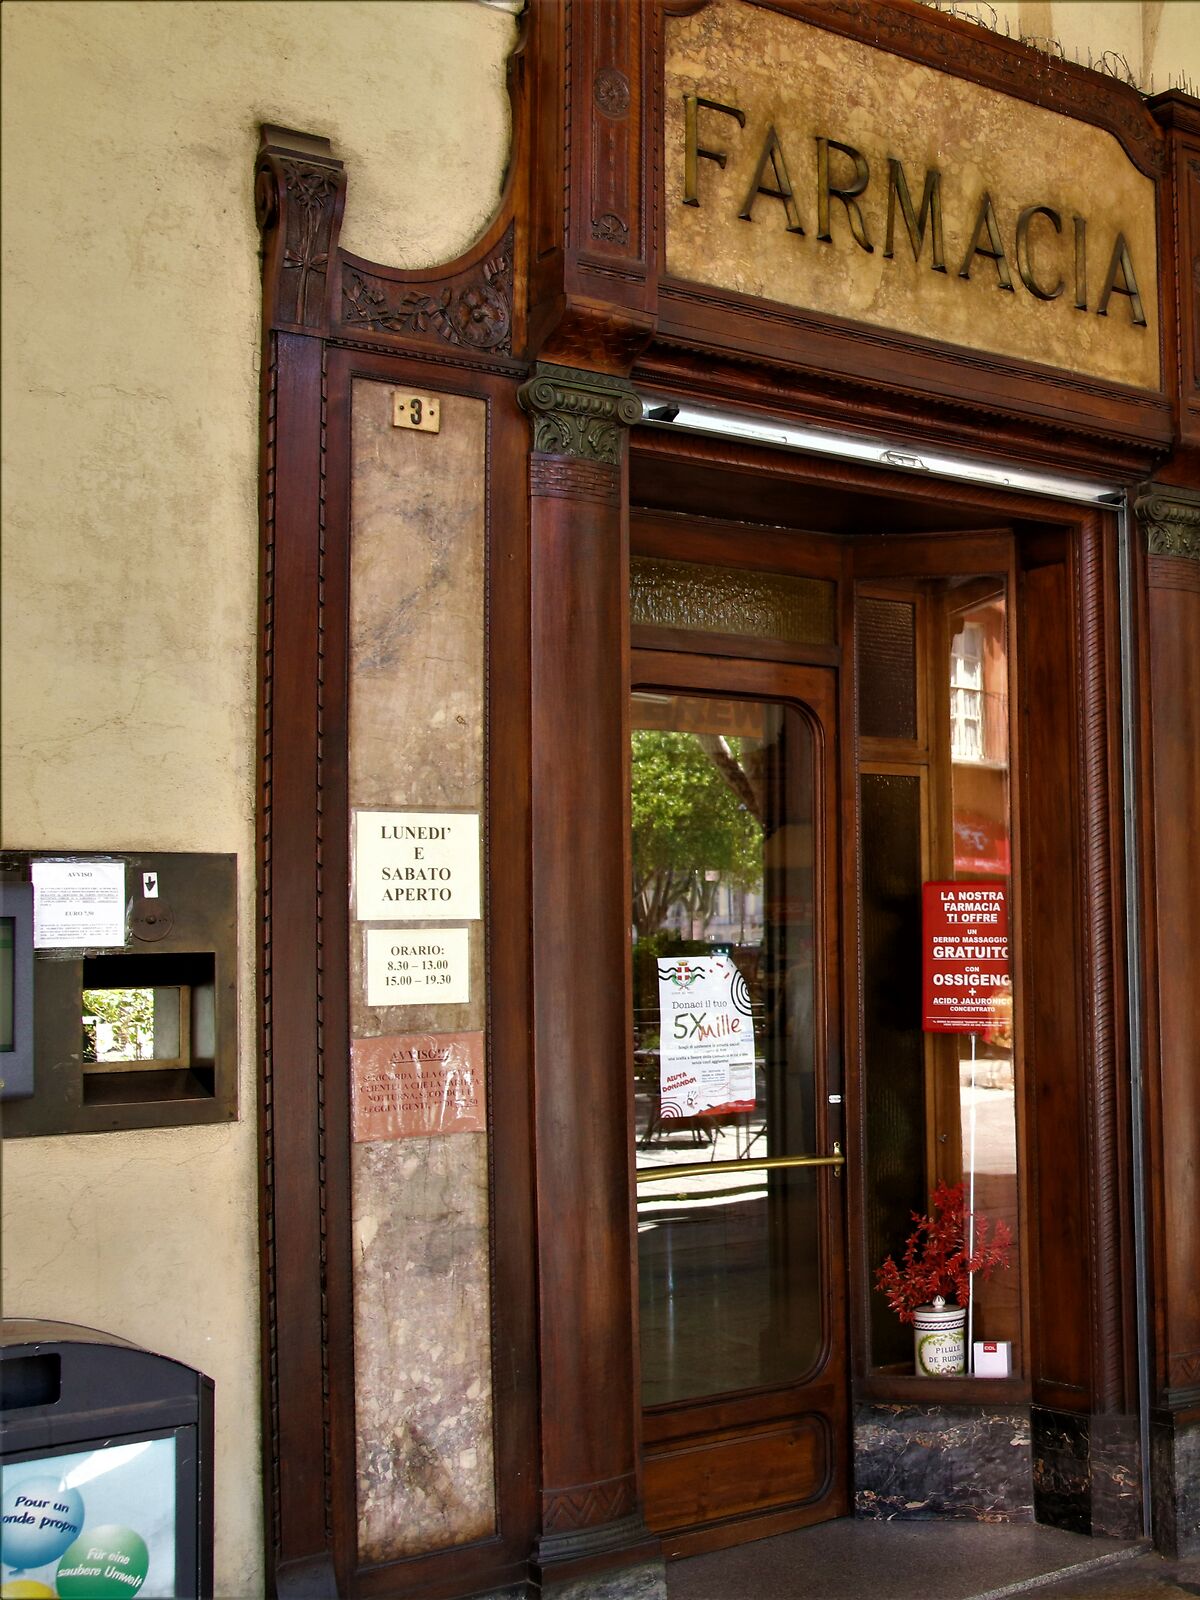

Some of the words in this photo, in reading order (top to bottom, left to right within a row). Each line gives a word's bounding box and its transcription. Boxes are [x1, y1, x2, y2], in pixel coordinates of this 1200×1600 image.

[683, 94, 1147, 327] FARMACIA
[410, 399, 422, 425] 3
[414, 847, 425, 860] E
[381, 867, 452, 882] SABATO
[381, 887, 452, 902] APERTO
[940, 892, 955, 900] LA
[958, 892, 1004, 900] NOSTRA
[944, 903, 1001, 911] FARMACIA
[946, 914, 958, 922] TI
[961, 914, 998, 922] OFFRE
[390, 945, 445, 956] ORARIO:
[387, 960, 409, 971] 8.30
[421, 960, 449, 971] 13.00
[385, 976, 412, 986] 15.00
[424, 974, 452, 985] 19.30
[672, 1000, 704, 1009] Donaci
[705, 1000, 711, 1008] il
[936, 1345, 961, 1354] PILULE
[15, 1496, 50, 1508] Pour
[53, 1502, 70, 1513] un
[108, 1550, 130, 1565] eine
[57, 1564, 101, 1578] saubere
[104, 1566, 144, 1589] Umwelt
